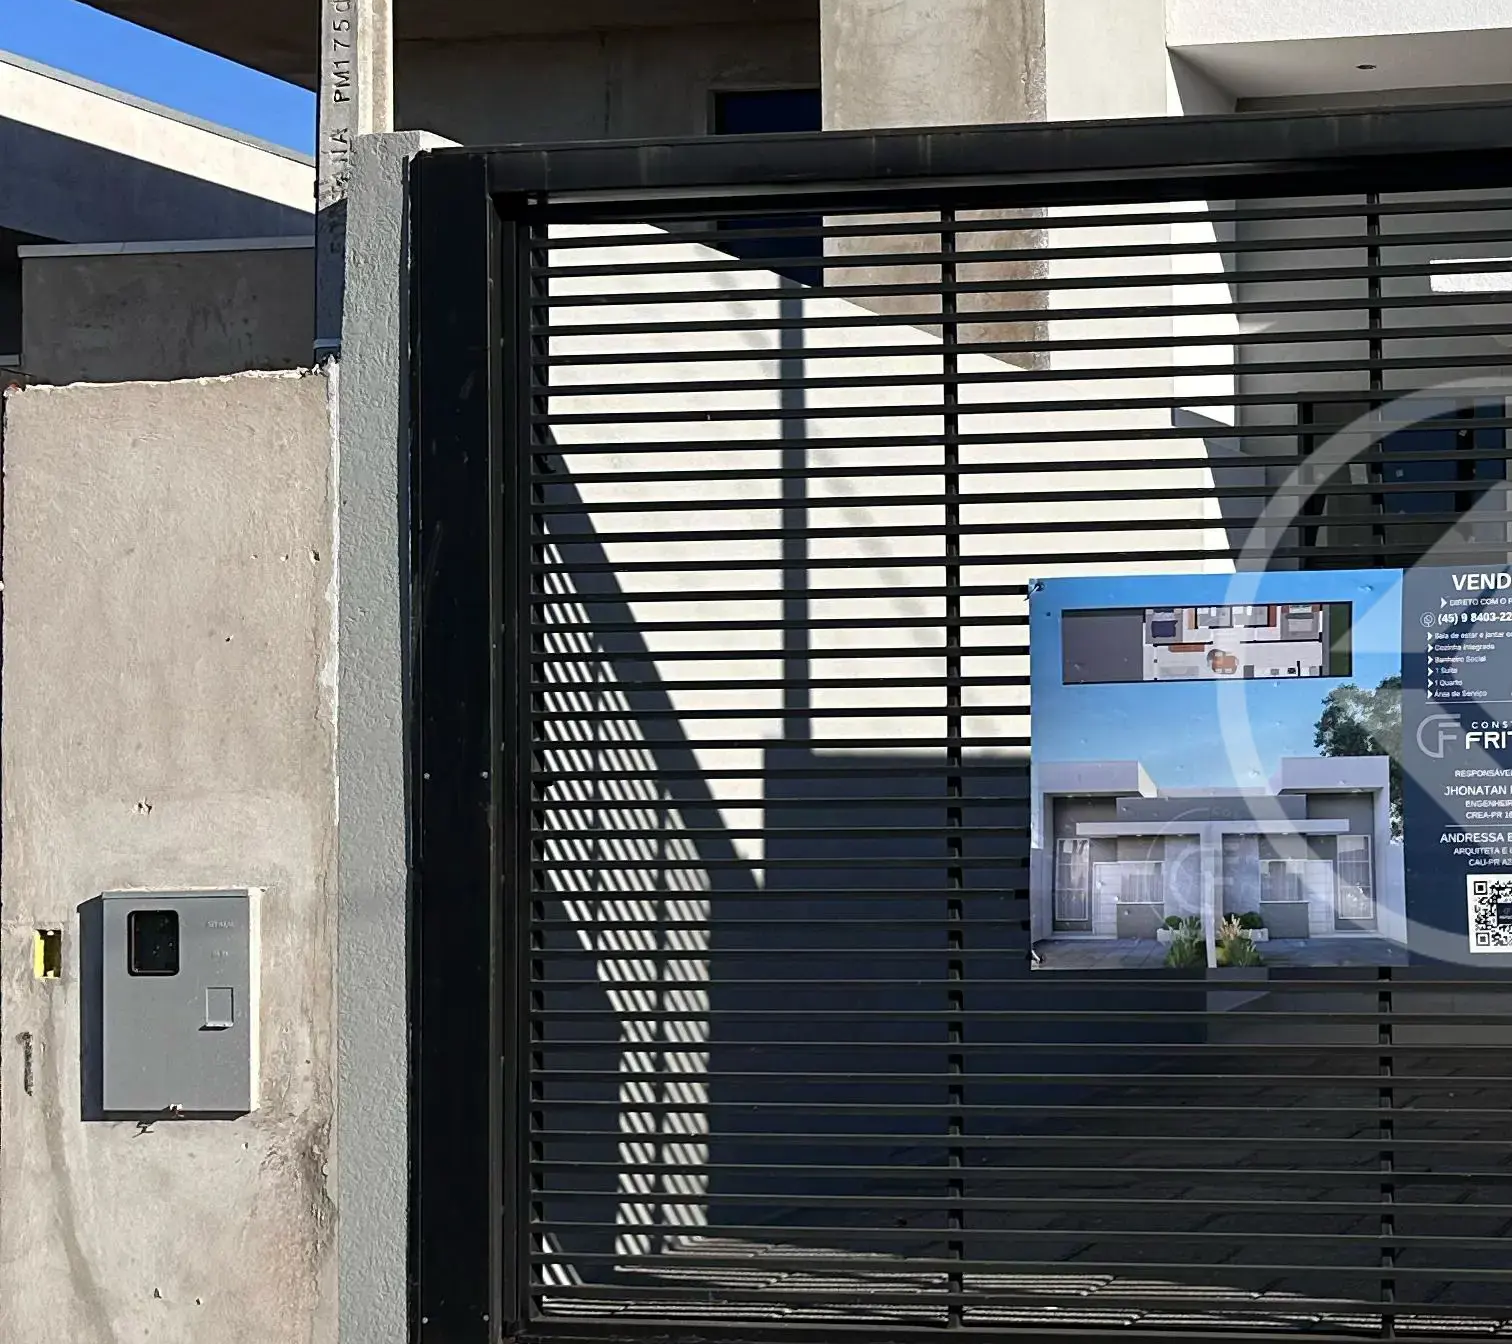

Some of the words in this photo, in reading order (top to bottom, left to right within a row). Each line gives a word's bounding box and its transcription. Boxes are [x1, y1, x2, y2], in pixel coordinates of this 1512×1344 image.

[1450, 598, 1479, 607] DIRETO
[1480, 598, 1499, 606] COM
[1500, 597, 1507, 605] O
[1438, 613, 1458, 625] (45)
[1461, 613, 1467, 623] 9
[1465, 655, 1487, 663] Social
[1439, 679, 1463, 687] Quarto
[1443, 785, 1507, 796] JHONATAN
[1465, 811, 1503, 819] CREA-PR
[1440, 832, 1505, 844] ANDRESSA
[1453, 847, 1500, 856] ARQUITETA
[1501, 846, 1508, 855] E
[1468, 858, 1500, 867] CAU-PR
